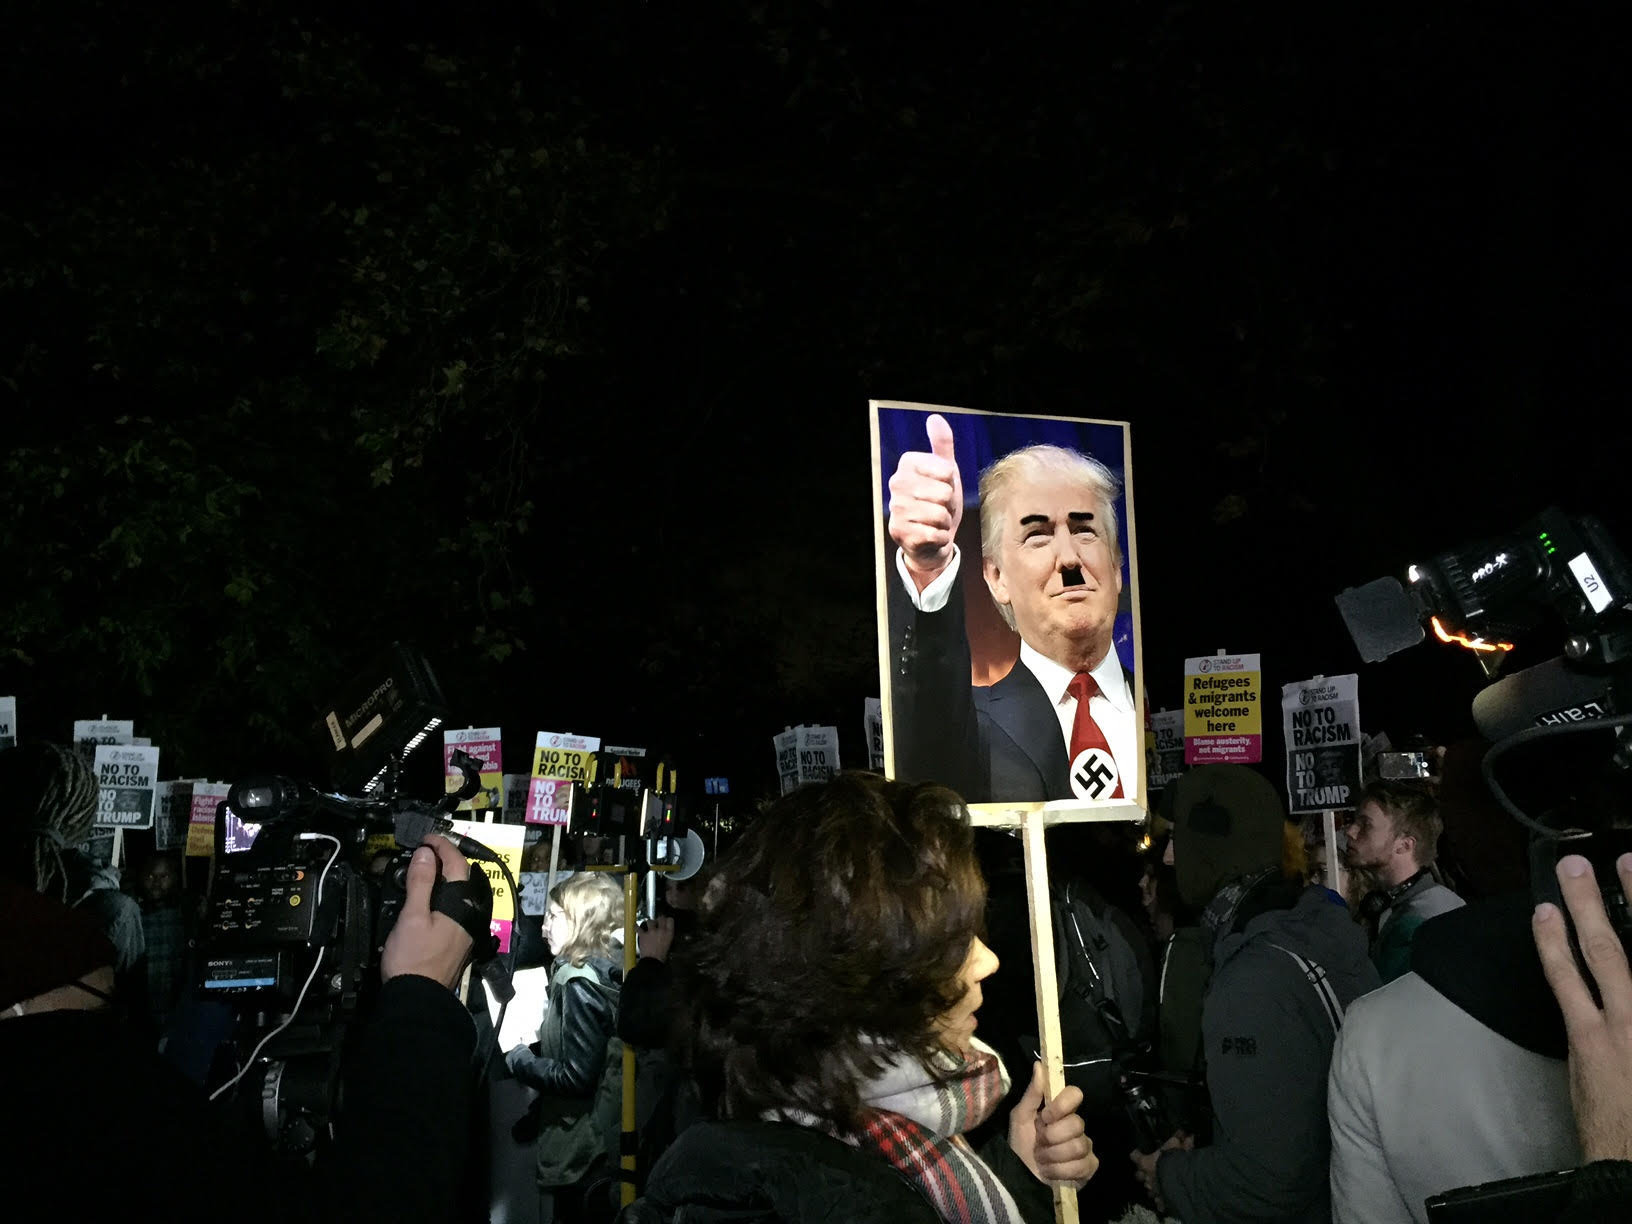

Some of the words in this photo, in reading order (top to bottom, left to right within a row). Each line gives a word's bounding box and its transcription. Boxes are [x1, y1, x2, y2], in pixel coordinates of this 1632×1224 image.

[1583, 574, 1599, 593] U2
[1193, 677, 1250, 691] Refugees
[1188, 692, 1197, 705] &
[1200, 690, 1257, 706] migrants
[1195, 706, 1249, 718] welcome
[1292, 709, 1311, 728] NO
[1315, 707, 1335, 725] TO
[1207, 720, 1236, 732] here
[1159, 728, 1173, 739] TO
[1293, 723, 1351, 746] RACISM
[101, 737, 116, 746] TO
[1193, 738, 1215, 746] Blame
[469, 742, 496, 754] against
[779, 749, 788, 761] NO
[788, 747, 797, 758] TO
[1212, 745, 1246, 754] migrants
[541, 750, 560, 763] NO
[564, 752, 582, 766] TO
[801, 751, 812, 765] NO
[813, 751, 826, 765] TO
[1295, 752, 1315, 771] NO
[101, 764, 120, 775] NO
[124, 764, 140, 775] TO
[802, 766, 834, 780] RACISM
[100, 775, 149, 787] RACISM
[606, 777, 641, 788] REUGEES
[1296, 770, 1316, 789] TO
[536, 781, 556, 794] NO
[99, 790, 117, 801] NO
[534, 794, 553, 806] TO
[1297, 785, 1351, 806] TRUMP
[98, 801, 115, 812] TO
[96, 811, 142, 823] TRUMP
[532, 807, 569, 822] TRUM
